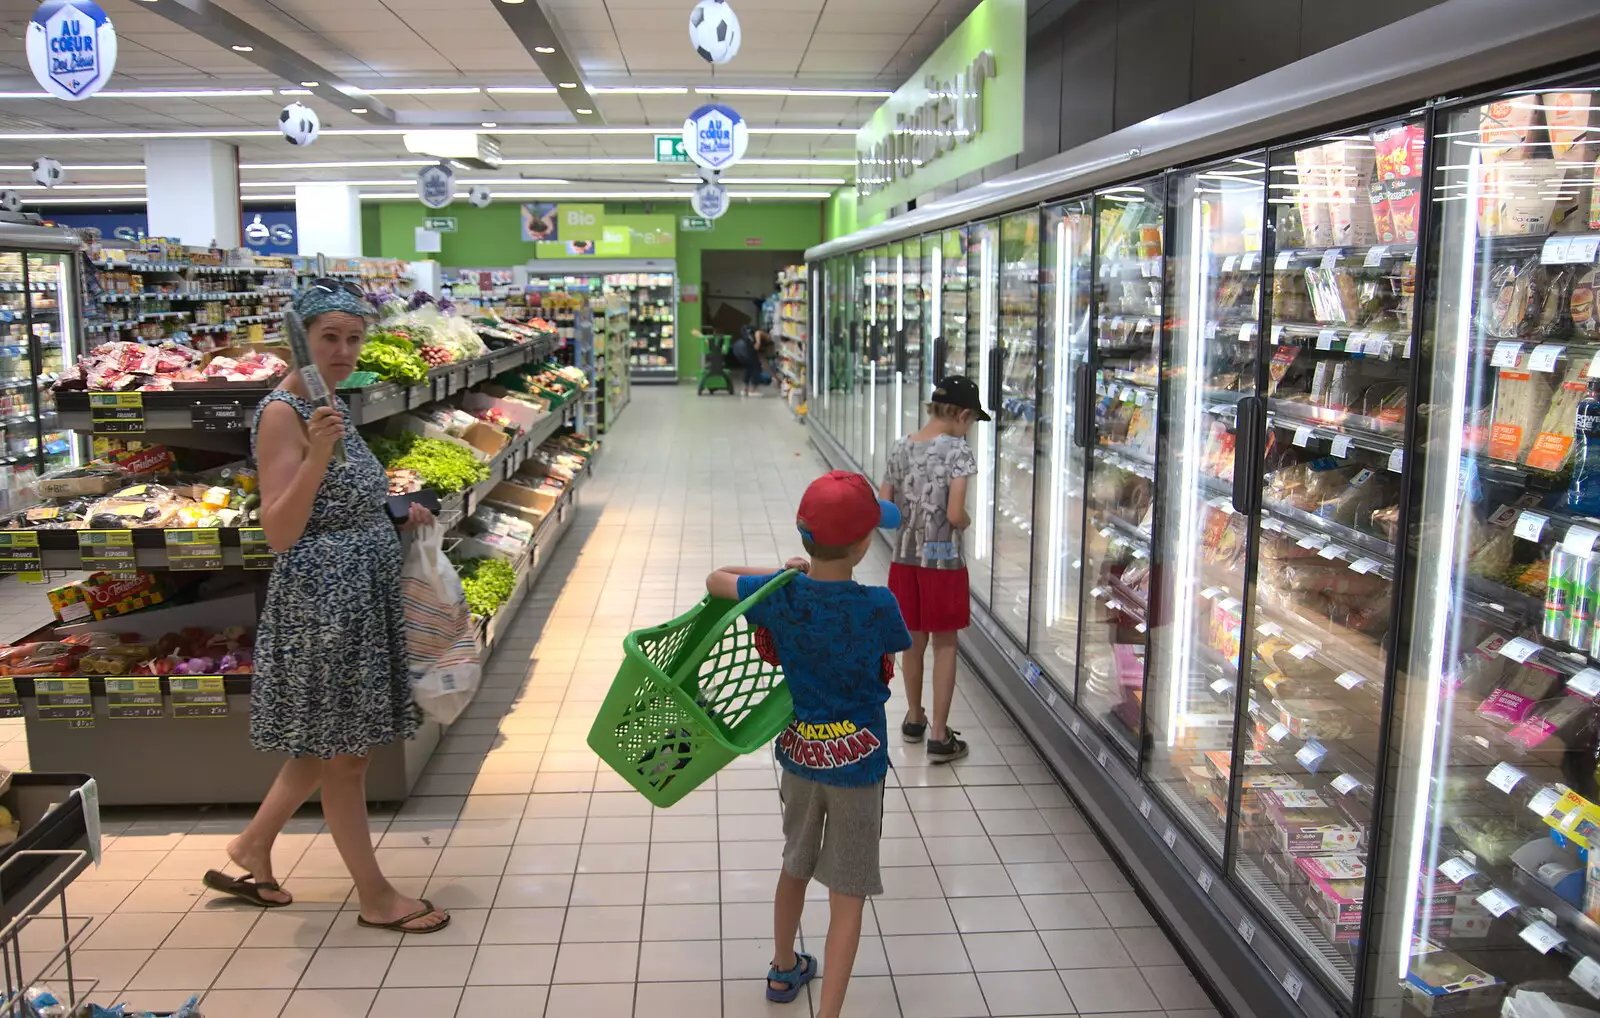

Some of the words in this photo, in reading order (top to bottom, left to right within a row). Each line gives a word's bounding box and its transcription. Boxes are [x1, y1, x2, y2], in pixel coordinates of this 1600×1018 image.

[62, 20, 80, 35] AU
[709, 120, 722, 130] AU
[567, 210, 596, 226] Bio
[780, 727, 880, 769] PIDER-MAN
